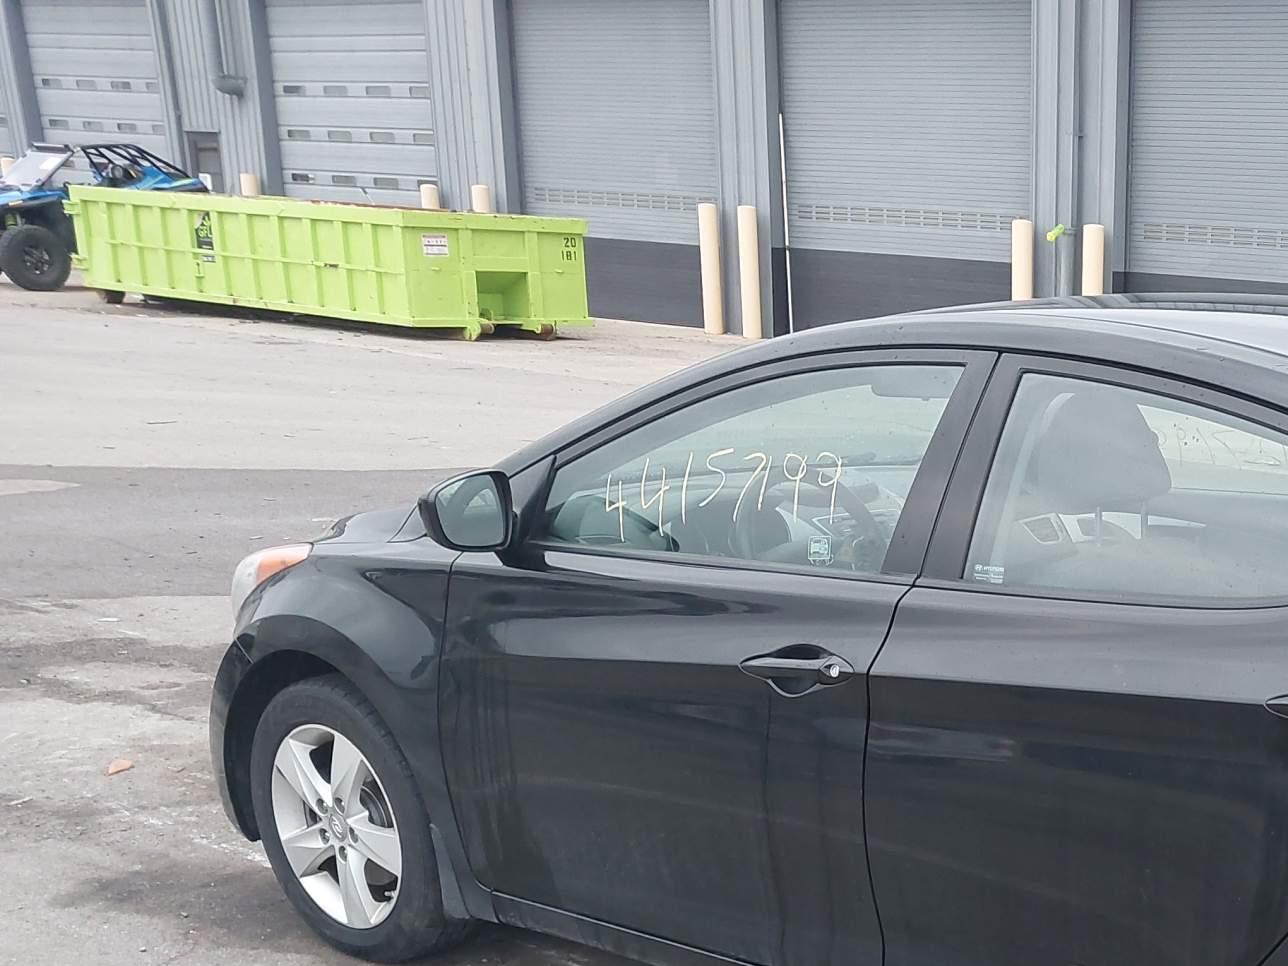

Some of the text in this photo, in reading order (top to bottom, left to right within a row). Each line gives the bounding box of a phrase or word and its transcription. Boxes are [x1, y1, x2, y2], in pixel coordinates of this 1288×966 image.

[563, 236, 577, 248] 20
[561, 250, 577, 261] 181
[604, 447, 846, 543] 44157199
